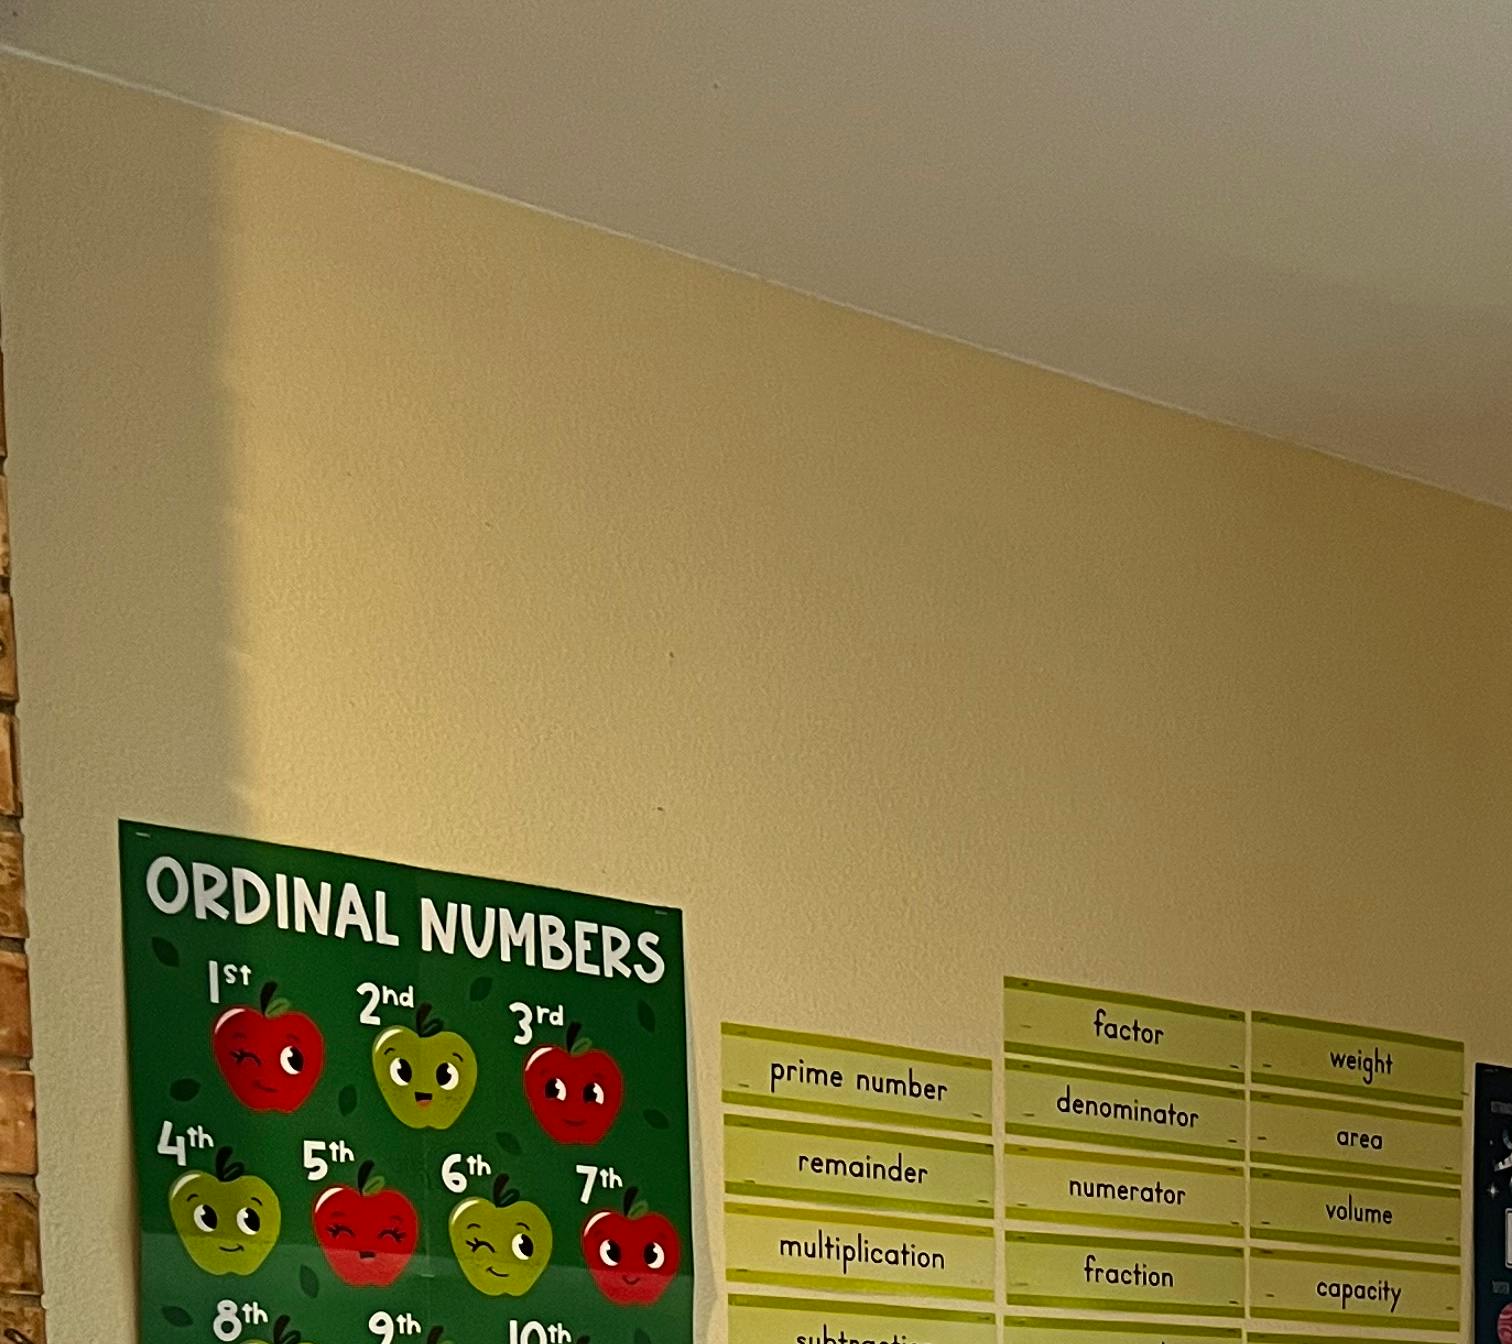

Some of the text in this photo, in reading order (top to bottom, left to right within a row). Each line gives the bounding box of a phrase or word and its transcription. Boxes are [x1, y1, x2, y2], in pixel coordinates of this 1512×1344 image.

[145, 855, 666, 984] ORDINAL NUMBERS
[207, 960, 252, 1003] 1st
[356, 981, 415, 1027] 2nd
[508, 1001, 564, 1046] 3rd
[1094, 1008, 1164, 1045] factor
[771, 1059, 948, 1101] prime number
[1330, 1047, 1393, 1085] weight
[1057, 1085, 1199, 1129] denominator
[157, 1120, 214, 1167] 4th
[1336, 1128, 1383, 1151] area
[302, 1139, 354, 1182] 5th
[441, 1152, 491, 1193] 6th
[799, 1153, 928, 1184] remainder
[575, 1164, 623, 1205] 7th
[1069, 1178, 1186, 1206] numerator
[1326, 1194, 1393, 1225] volume
[780, 1229, 945, 1274] multiplication
[1084, 1255, 1174, 1288] fraction
[1316, 1278, 1402, 1314] capacity
[212, 1299, 269, 1342] 8th
